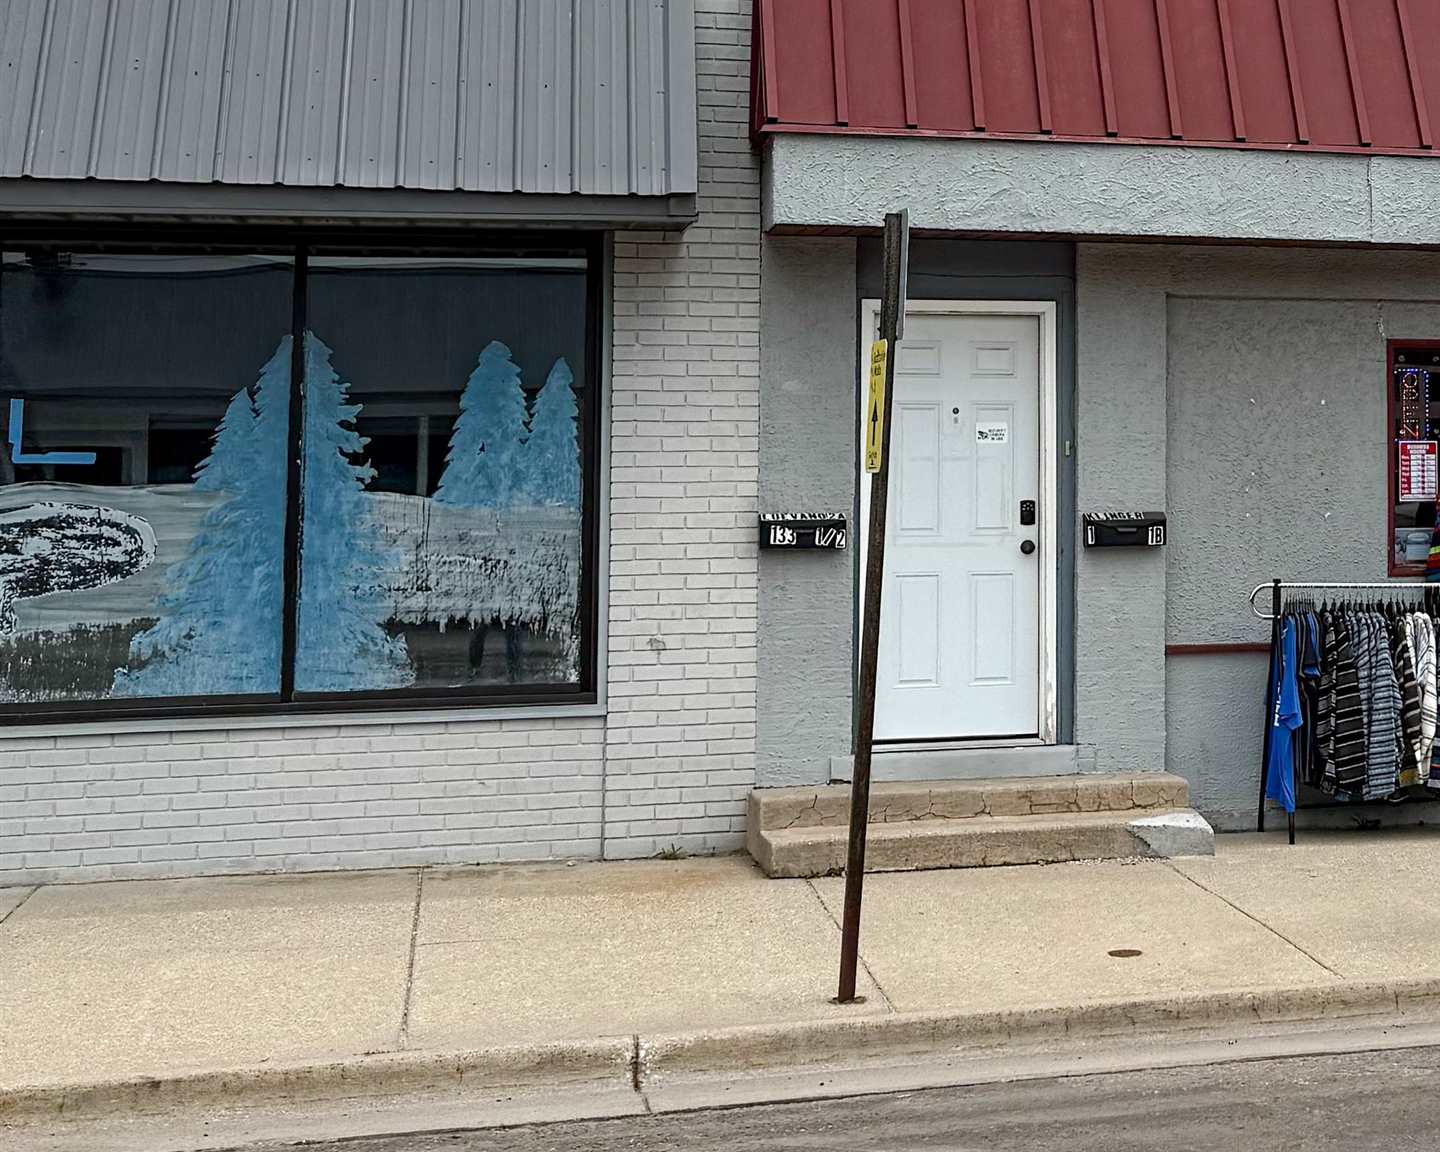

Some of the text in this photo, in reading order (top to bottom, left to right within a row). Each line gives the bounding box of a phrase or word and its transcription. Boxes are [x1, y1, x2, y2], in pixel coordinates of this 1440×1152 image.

[771, 526, 845, 547] 133 1/2
[1149, 527, 1162, 544] 1B
